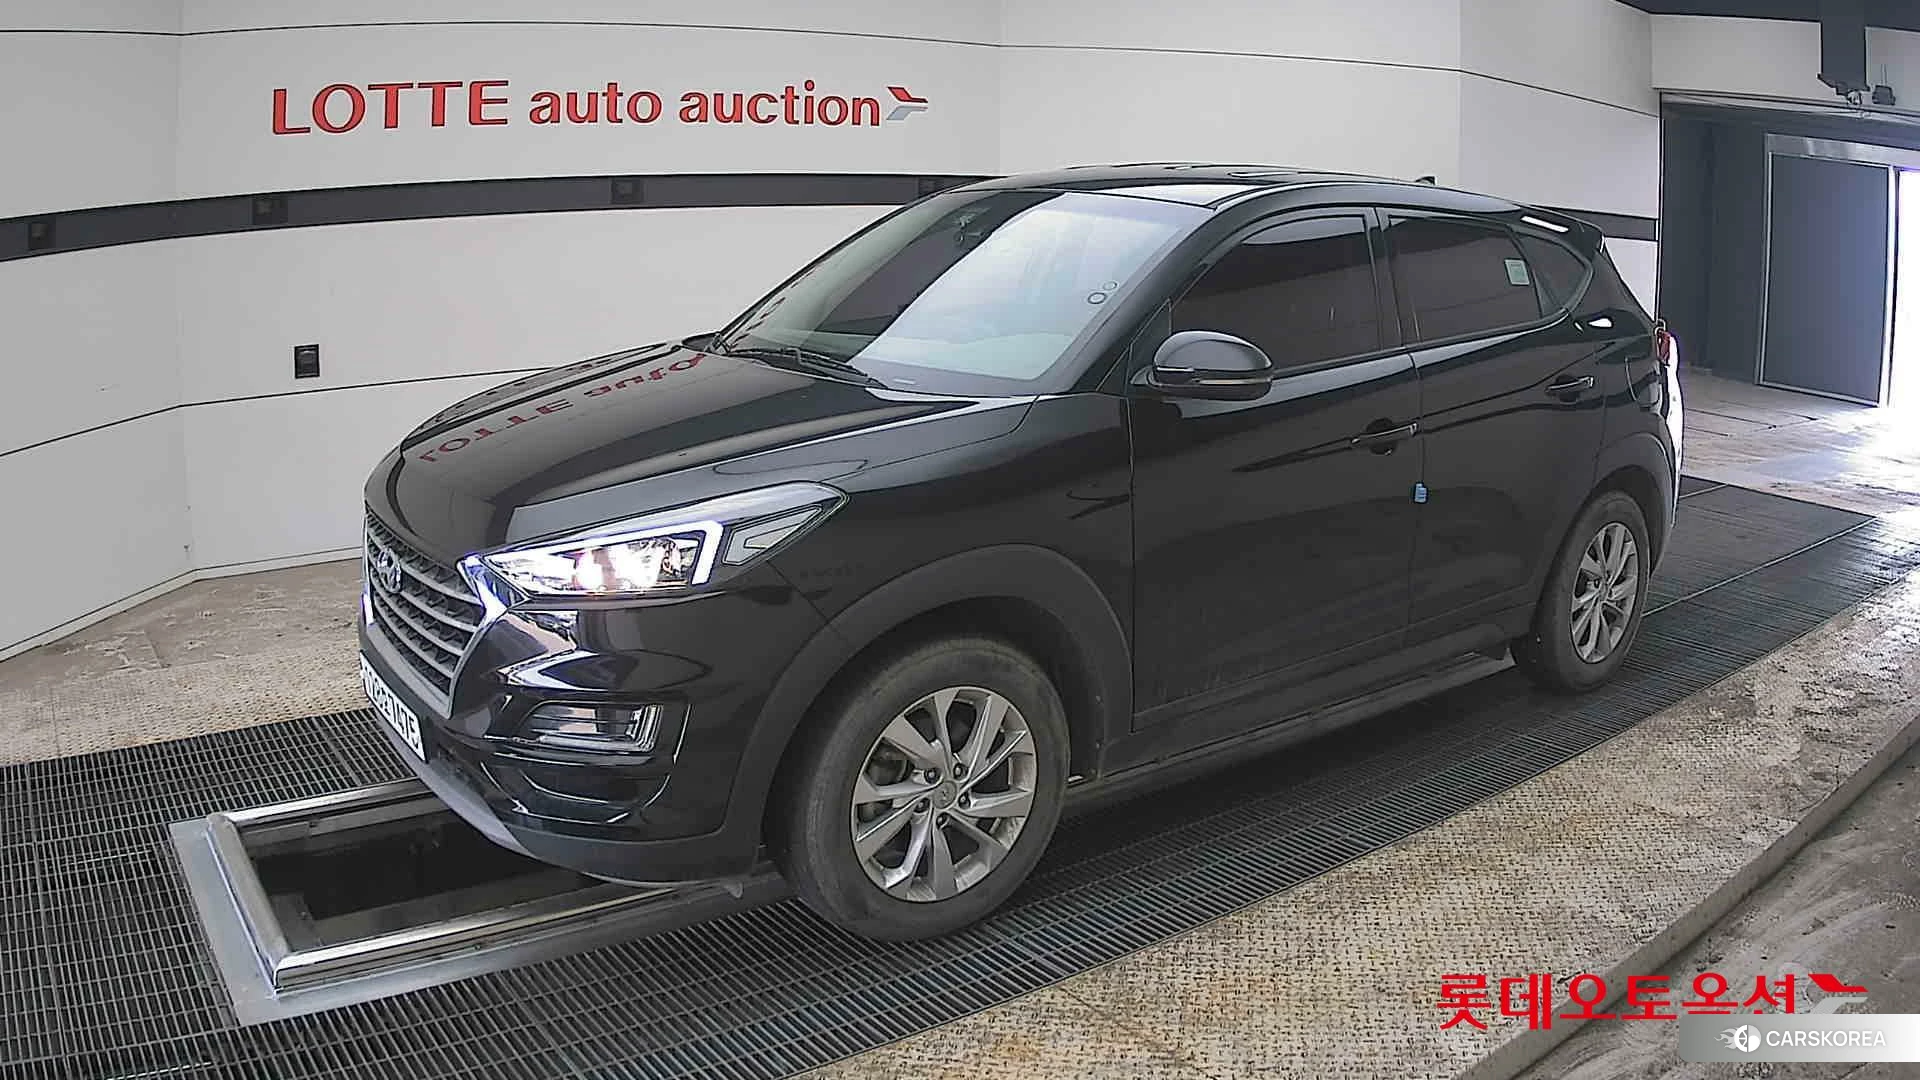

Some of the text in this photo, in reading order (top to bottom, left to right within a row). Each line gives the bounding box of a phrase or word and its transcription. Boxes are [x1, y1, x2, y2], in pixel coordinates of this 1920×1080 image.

[272, 80, 881, 136] LOTTE auto auction
